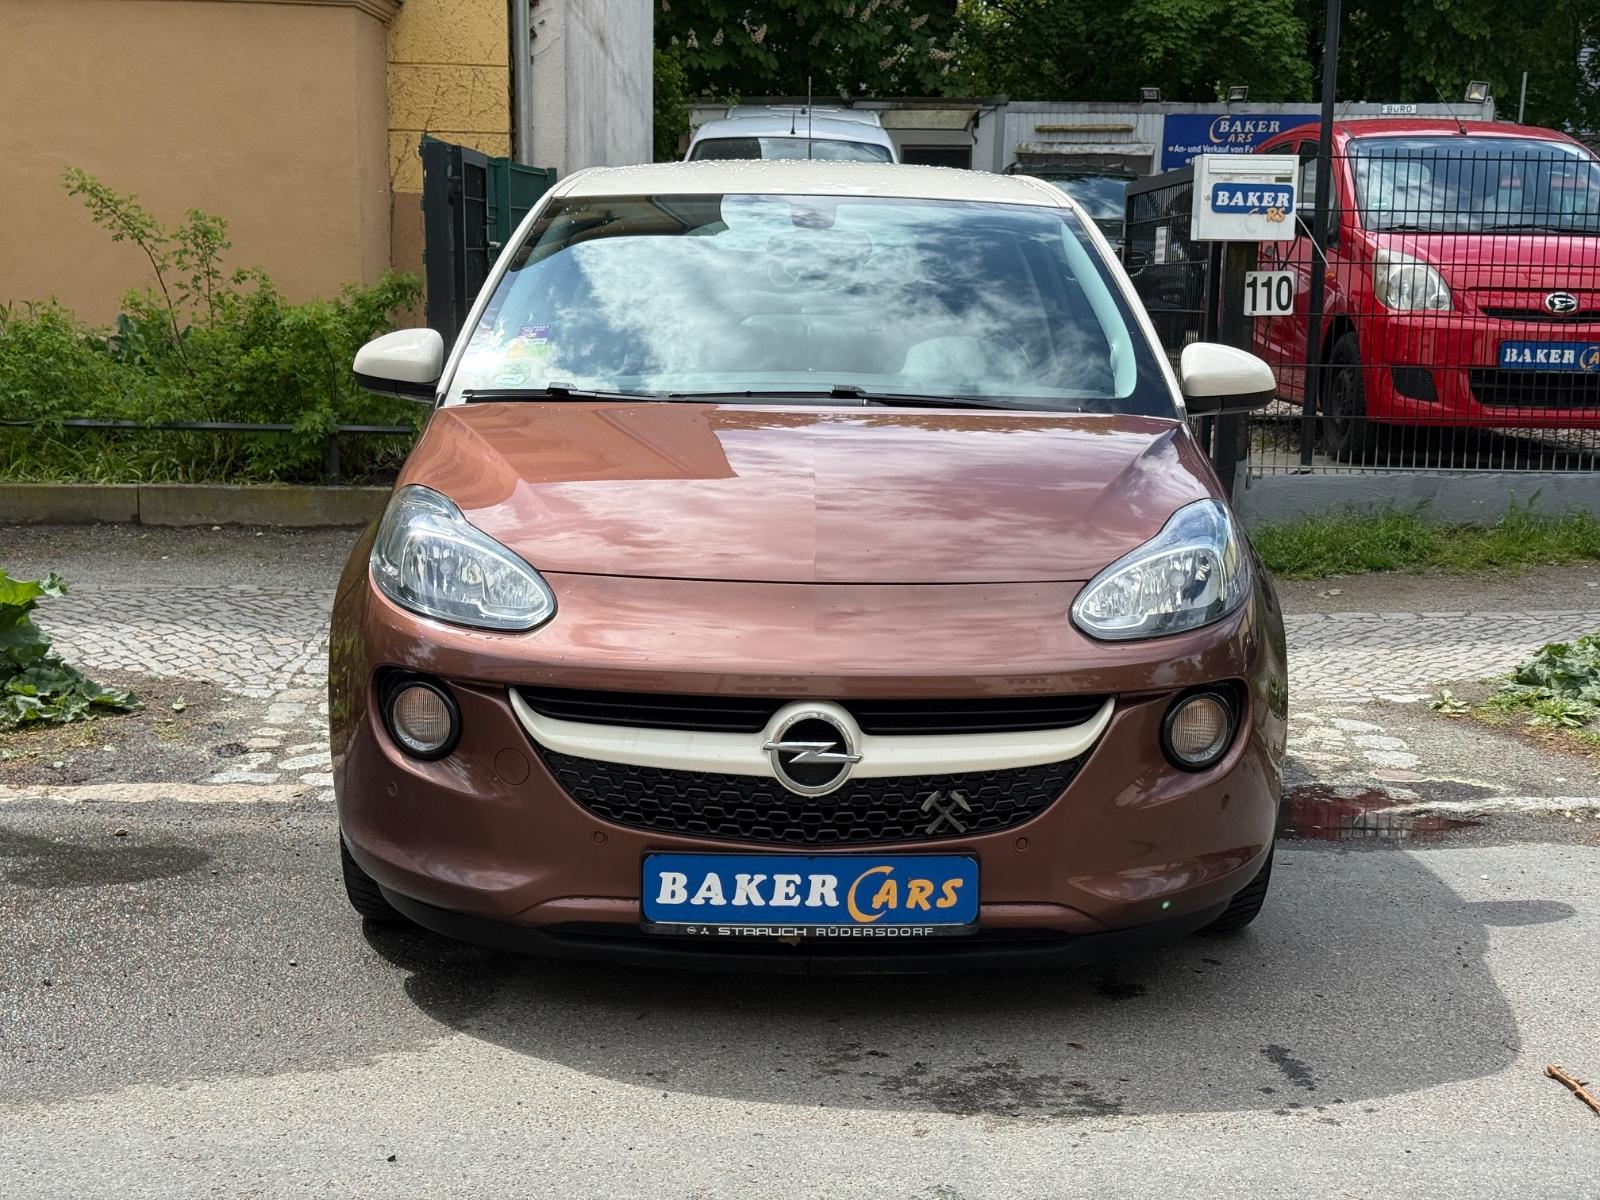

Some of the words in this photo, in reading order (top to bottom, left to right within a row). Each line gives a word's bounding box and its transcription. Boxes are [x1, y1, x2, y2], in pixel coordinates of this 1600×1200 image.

[1219, 120, 1280, 133] BAKER
[1174, 144, 1186, 153] An-
[1188, 144, 1201, 153] und
[1203, 144, 1229, 153] Verkauf
[1230, 145, 1242, 153] von
[1245, 144, 1257, 153] Fa
[1216, 191, 1290, 207] BAKER
[1246, 275, 1293, 311] 110
[1504, 348, 1575, 364] BAKER
[656, 871, 839, 907] BAKER
[718, 923, 807, 936] STRAUCH
[816, 921, 934, 936] RÜDERSDORF
